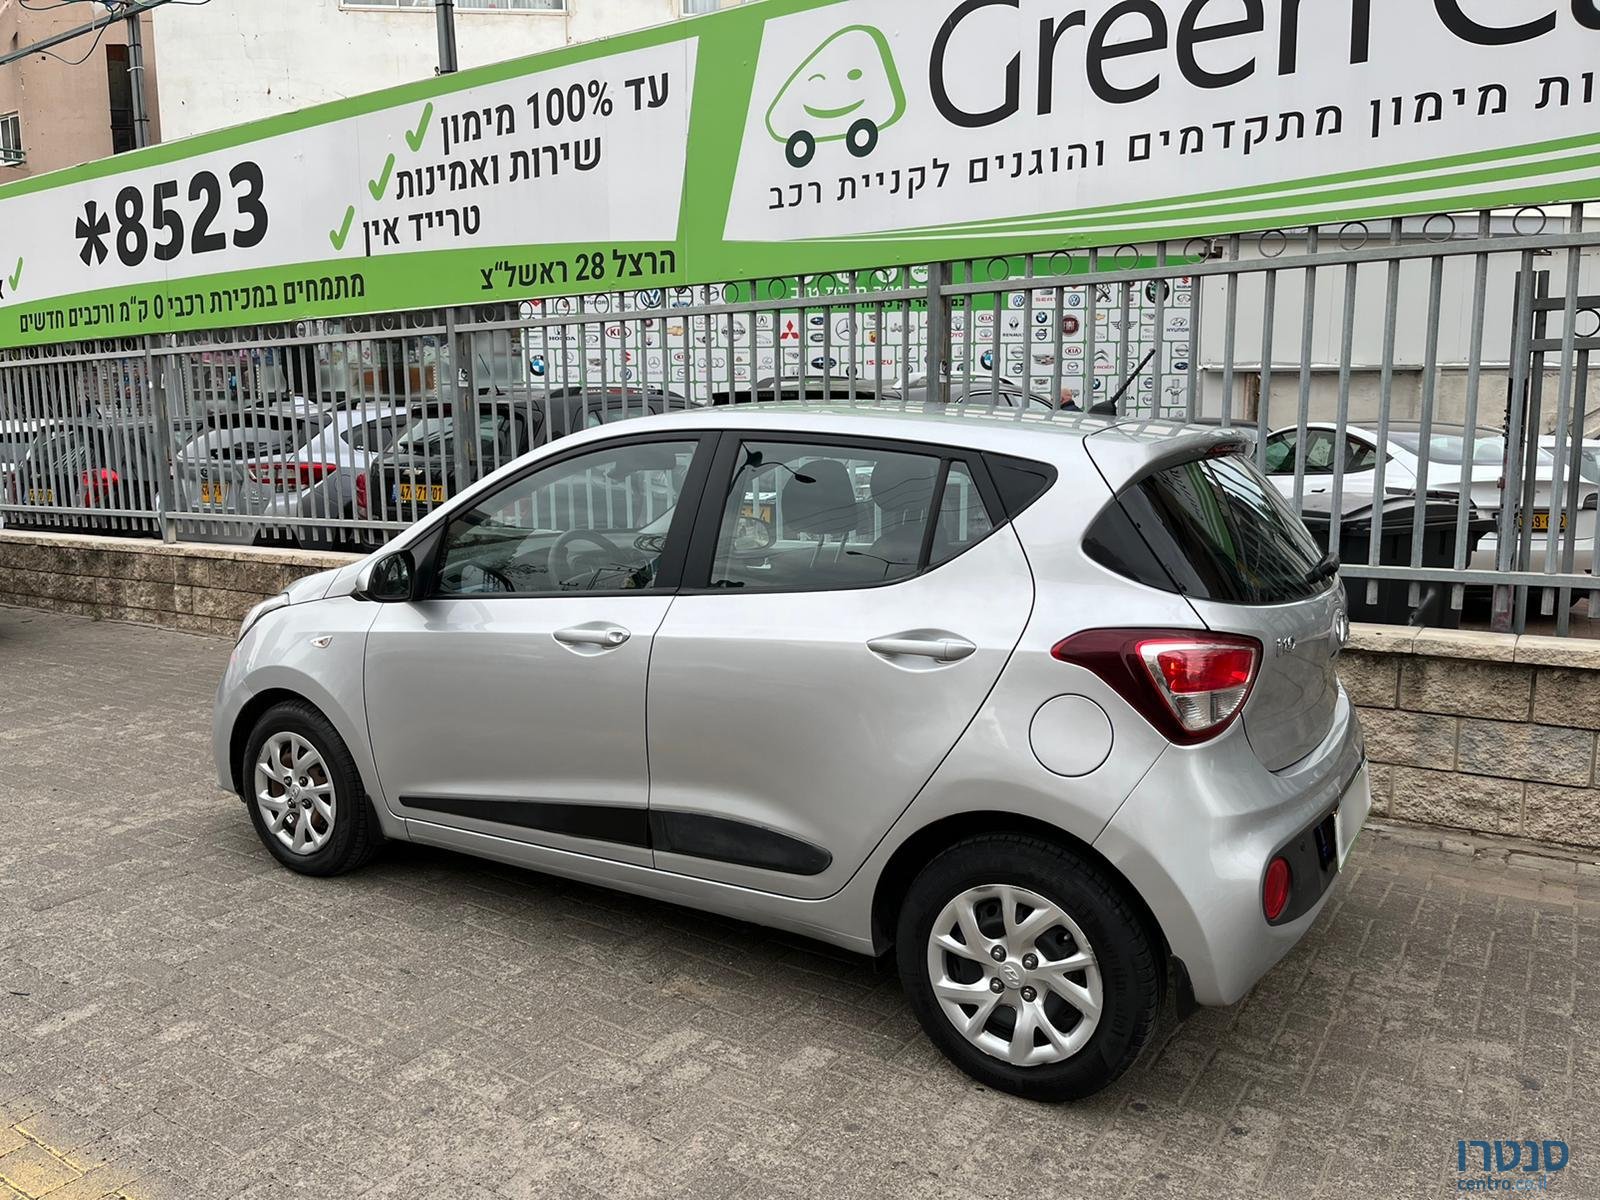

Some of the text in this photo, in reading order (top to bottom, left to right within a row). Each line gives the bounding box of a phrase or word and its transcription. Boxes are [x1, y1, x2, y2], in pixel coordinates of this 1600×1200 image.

[930, 0, 1371, 128] Green
[441, 72, 669, 156] עד 100% מימון
[1370, 83, 1507, 138] מימון
[1128, 105, 1342, 162] מתקדמים
[396, 136, 601, 200] שירות ואמינות
[969, 139, 1104, 184] והוגנים
[837, 157, 950, 199] לקניית
[769, 181, 821, 210] רכב
[362, 205, 482, 258] טרייד אין
[575, 251, 605, 282] 28
[612, 248, 676, 278] הרצל
[209, 285, 278, 315] במכירת
[283, 273, 365, 305] מתמחים
[20, 307, 65, 334] חדשים
[69, 301, 115, 328] ורכבים
[153, 294, 164, 320] 0
[167, 292, 205, 319] רכבי
